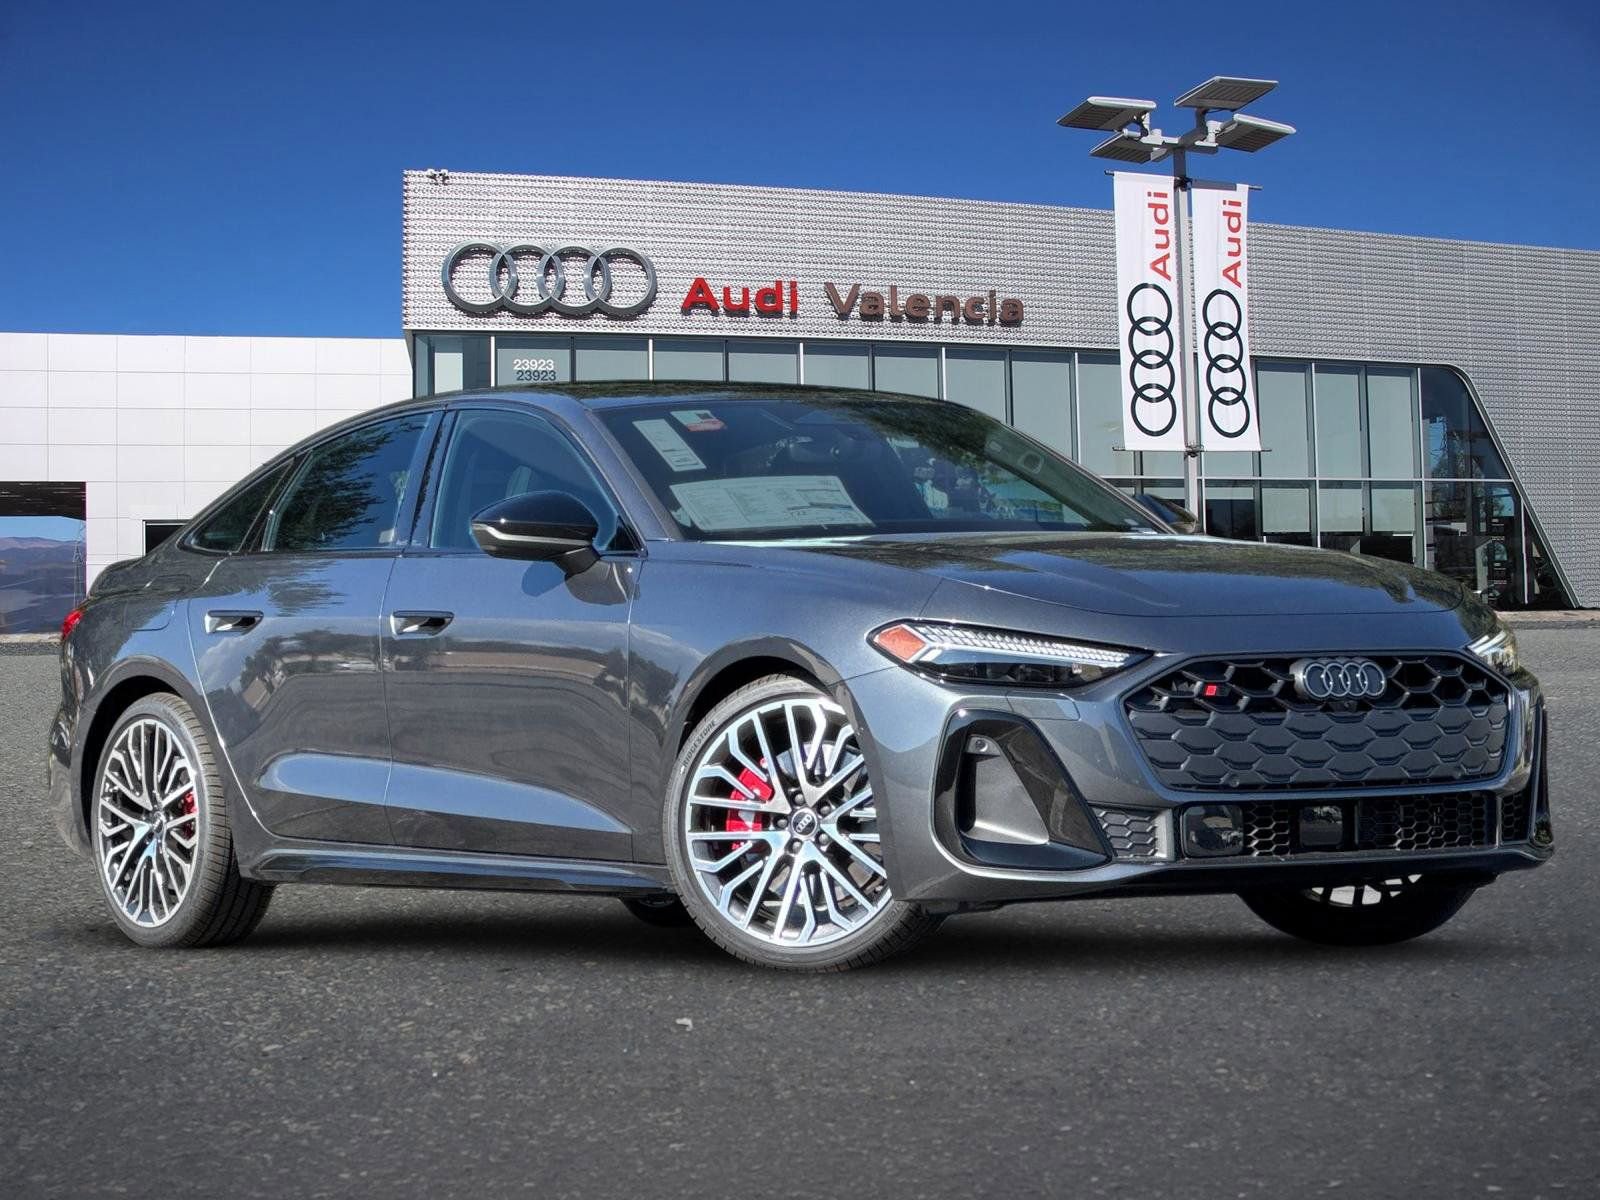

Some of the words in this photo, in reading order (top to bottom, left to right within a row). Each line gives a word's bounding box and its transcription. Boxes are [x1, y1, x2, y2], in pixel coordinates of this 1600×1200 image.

[1147, 191, 1172, 282] Audi
[1222, 199, 1242, 289] Audi
[681, 276, 798, 316] Audi
[824, 281, 1025, 326] Valencia
[513, 358, 554, 370] 23923
[516, 370, 556, 381] 23923
